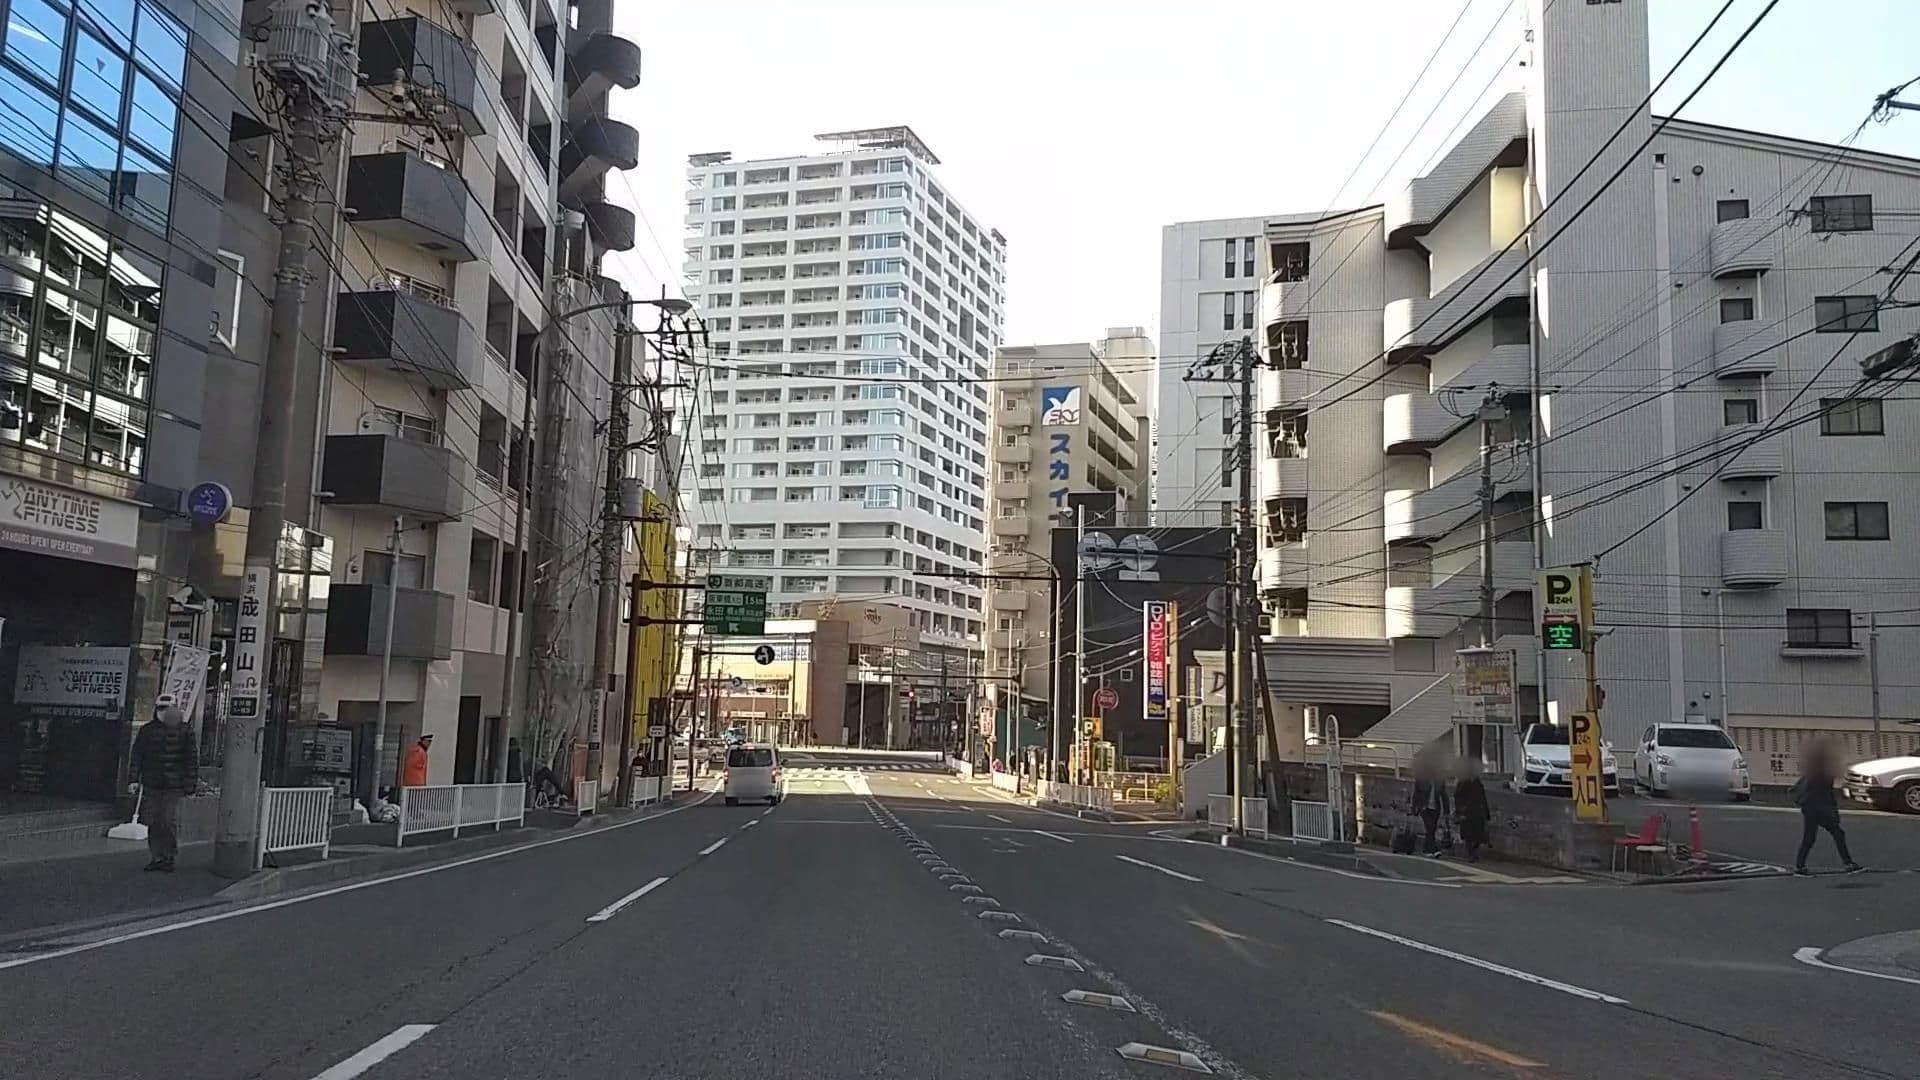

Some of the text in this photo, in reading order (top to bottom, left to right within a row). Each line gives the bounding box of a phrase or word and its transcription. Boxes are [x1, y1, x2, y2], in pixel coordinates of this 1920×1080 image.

[24, 486, 101, 519] ANYTIME
[24, 505, 99, 534] FITNESS
[1546, 574, 1571, 604] P
[1549, 625, 1574, 648] 空
[74, 683, 121, 695] FITNESS
[1571, 715, 1590, 745] P
[1576, 775, 1598, 807] 入口
